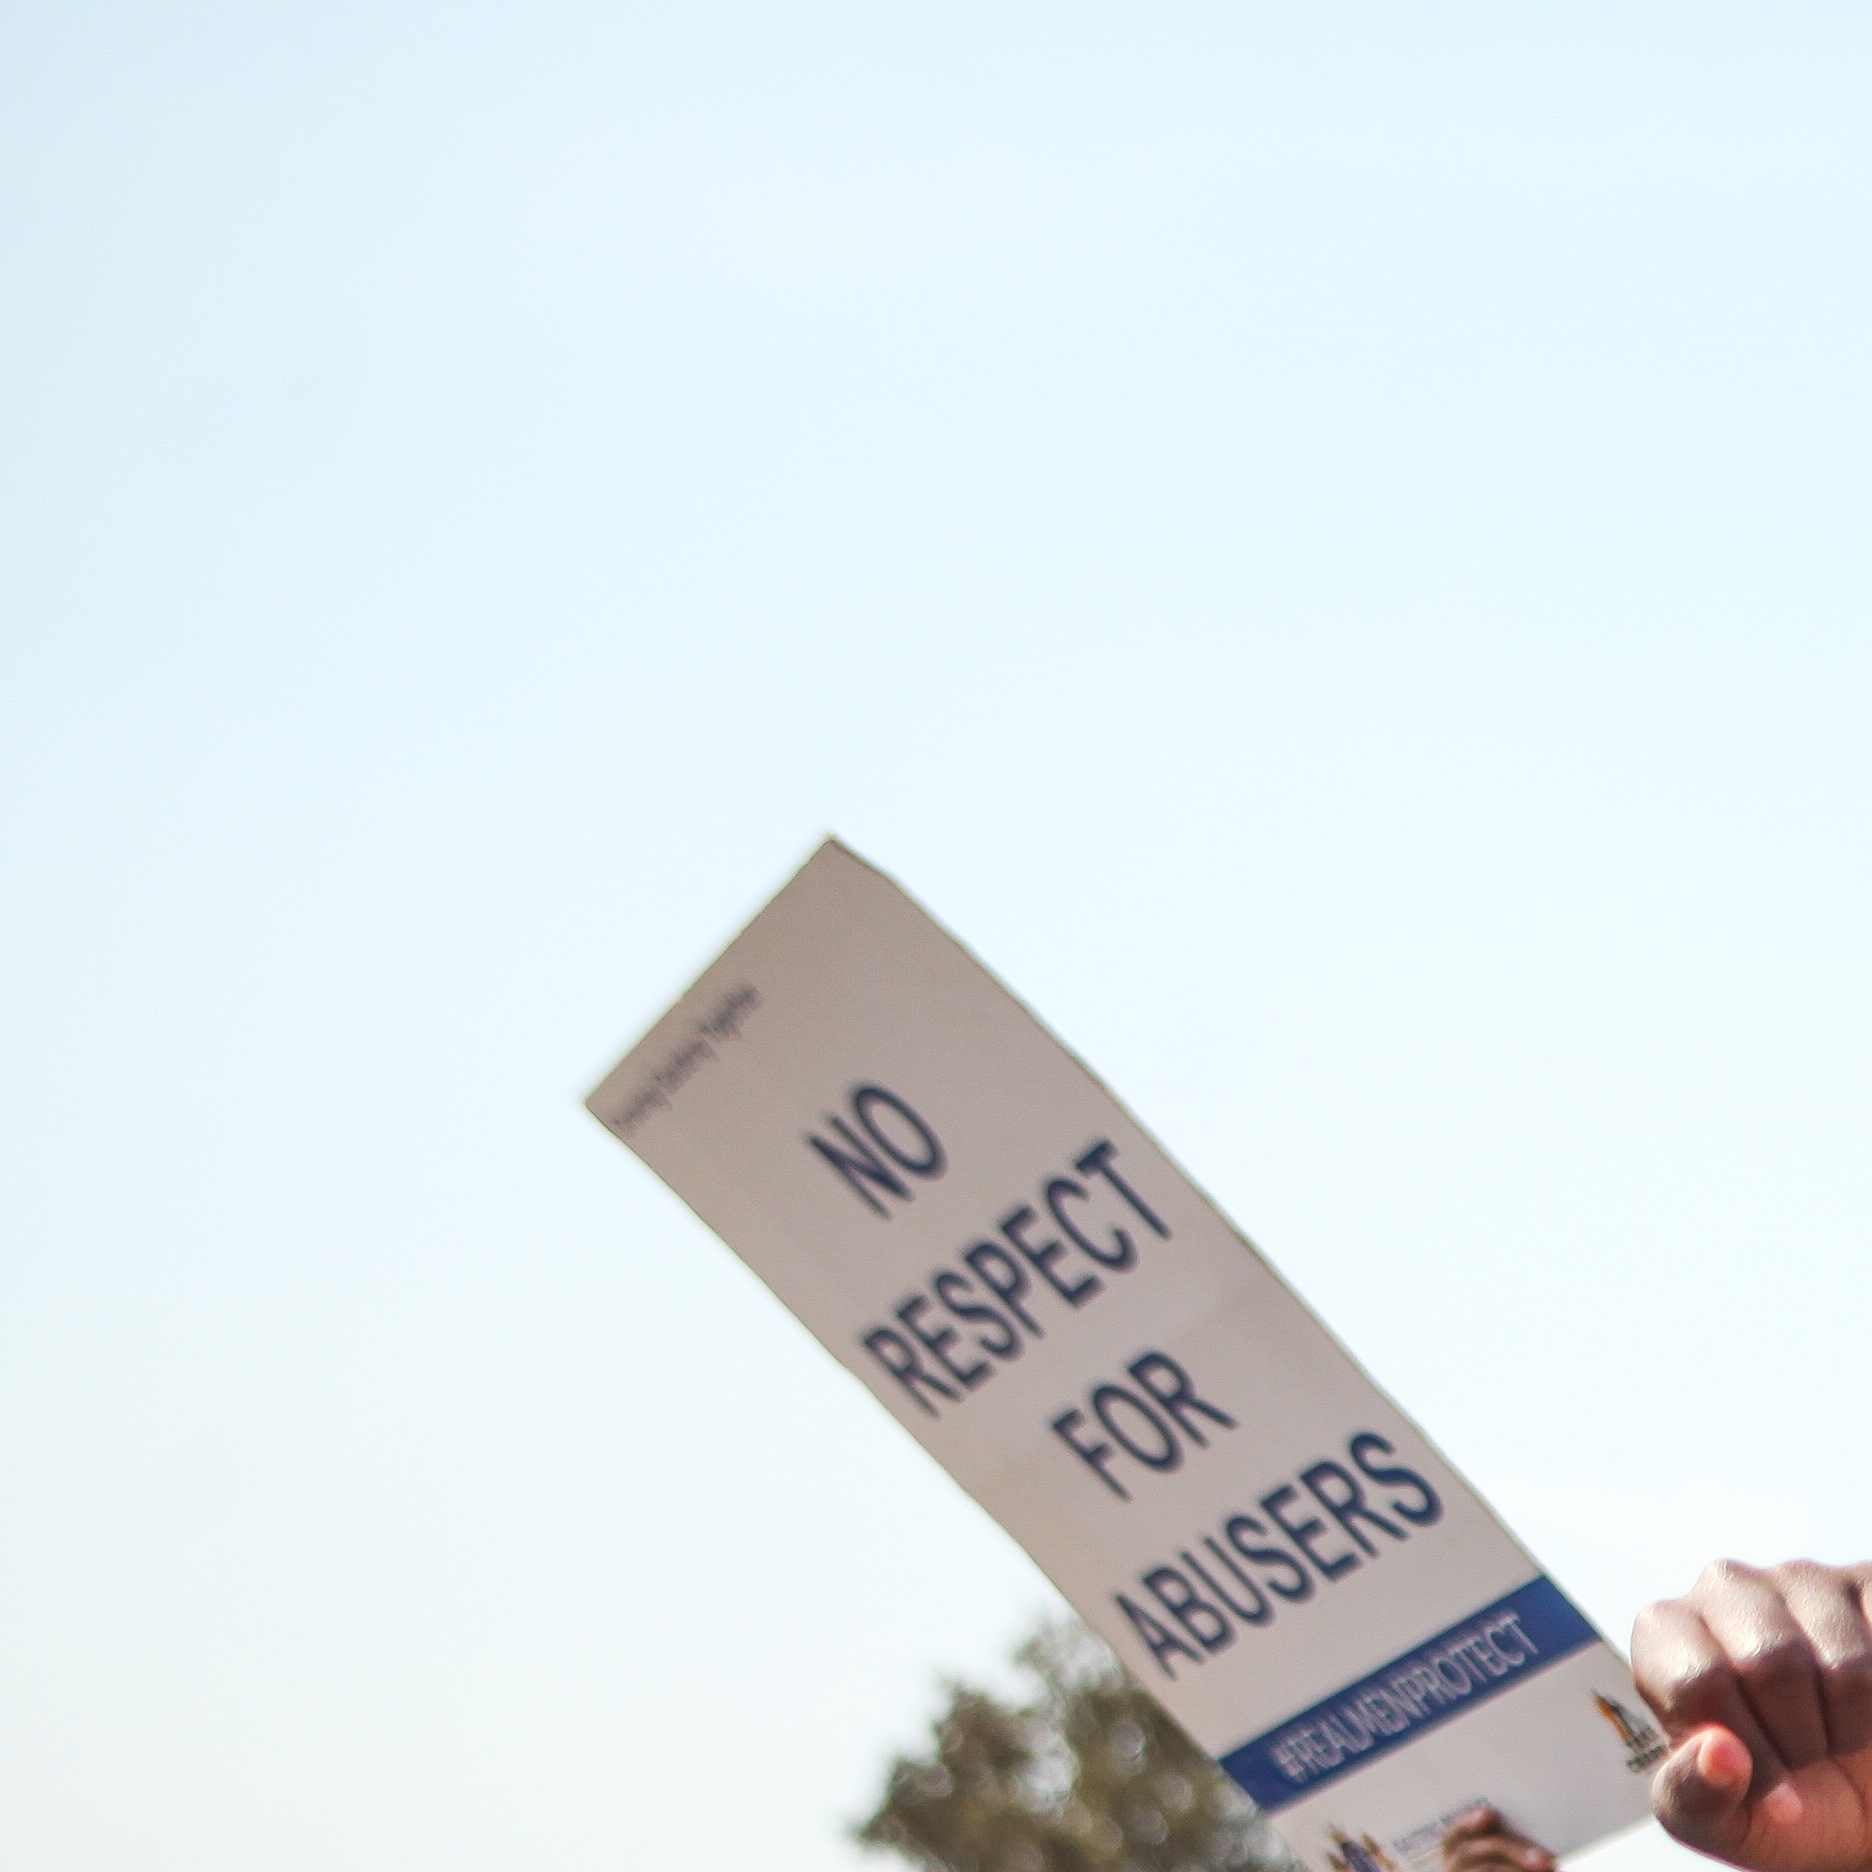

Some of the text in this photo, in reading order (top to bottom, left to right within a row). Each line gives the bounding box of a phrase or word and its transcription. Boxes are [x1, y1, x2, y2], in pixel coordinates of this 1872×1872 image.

[807, 1080, 947, 1220] NO
[861, 1137, 1173, 1420] RESPECT
[1051, 1350, 1238, 1503] FOR
[1113, 1430, 1443, 1680] ABUSERS
[1272, 1612, 1540, 1784] #REALMENPROTECT
